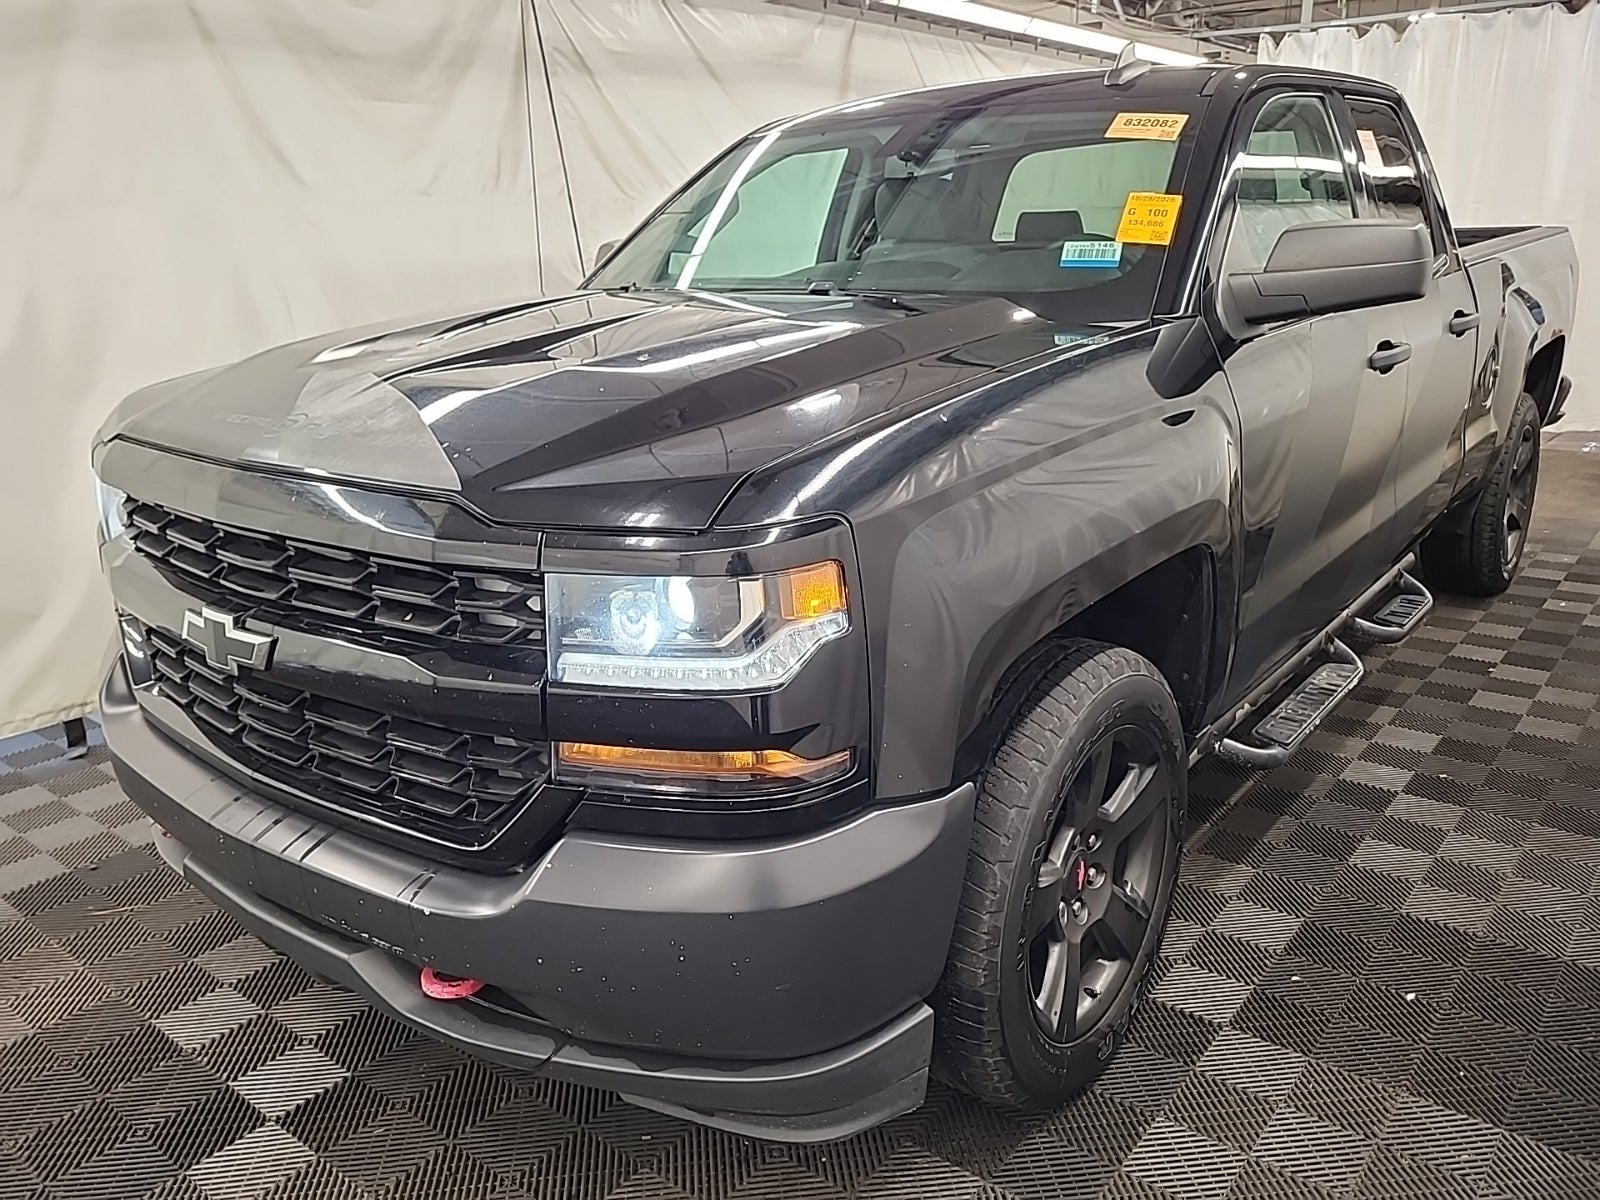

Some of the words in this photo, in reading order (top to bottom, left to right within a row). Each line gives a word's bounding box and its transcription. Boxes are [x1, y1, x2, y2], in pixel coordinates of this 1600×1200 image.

[1123, 118, 1179, 128] 832082
[1127, 207, 1137, 216] G
[1146, 208, 1169, 218] 100
